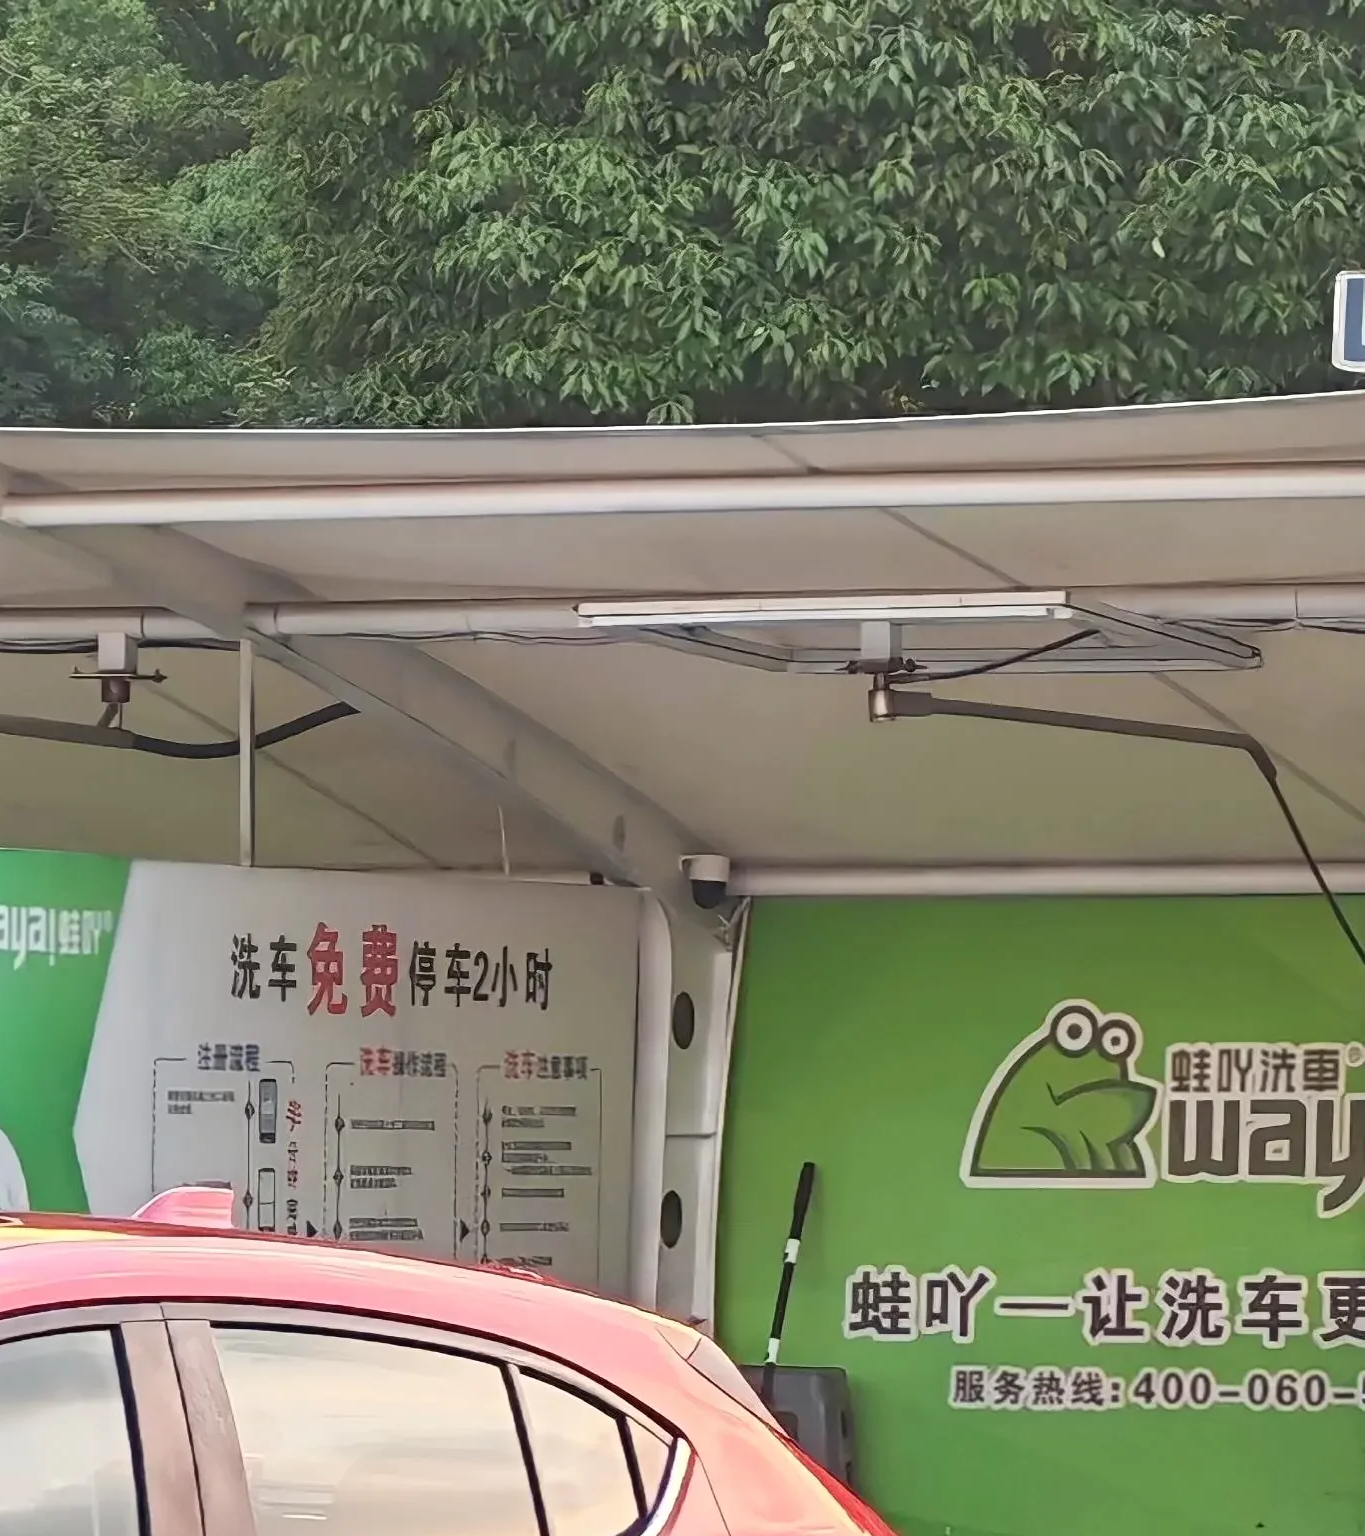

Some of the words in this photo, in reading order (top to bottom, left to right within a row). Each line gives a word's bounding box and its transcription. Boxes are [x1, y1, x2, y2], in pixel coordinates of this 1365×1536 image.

[231, 921, 553, 1018] 洗车免费停车2小时
